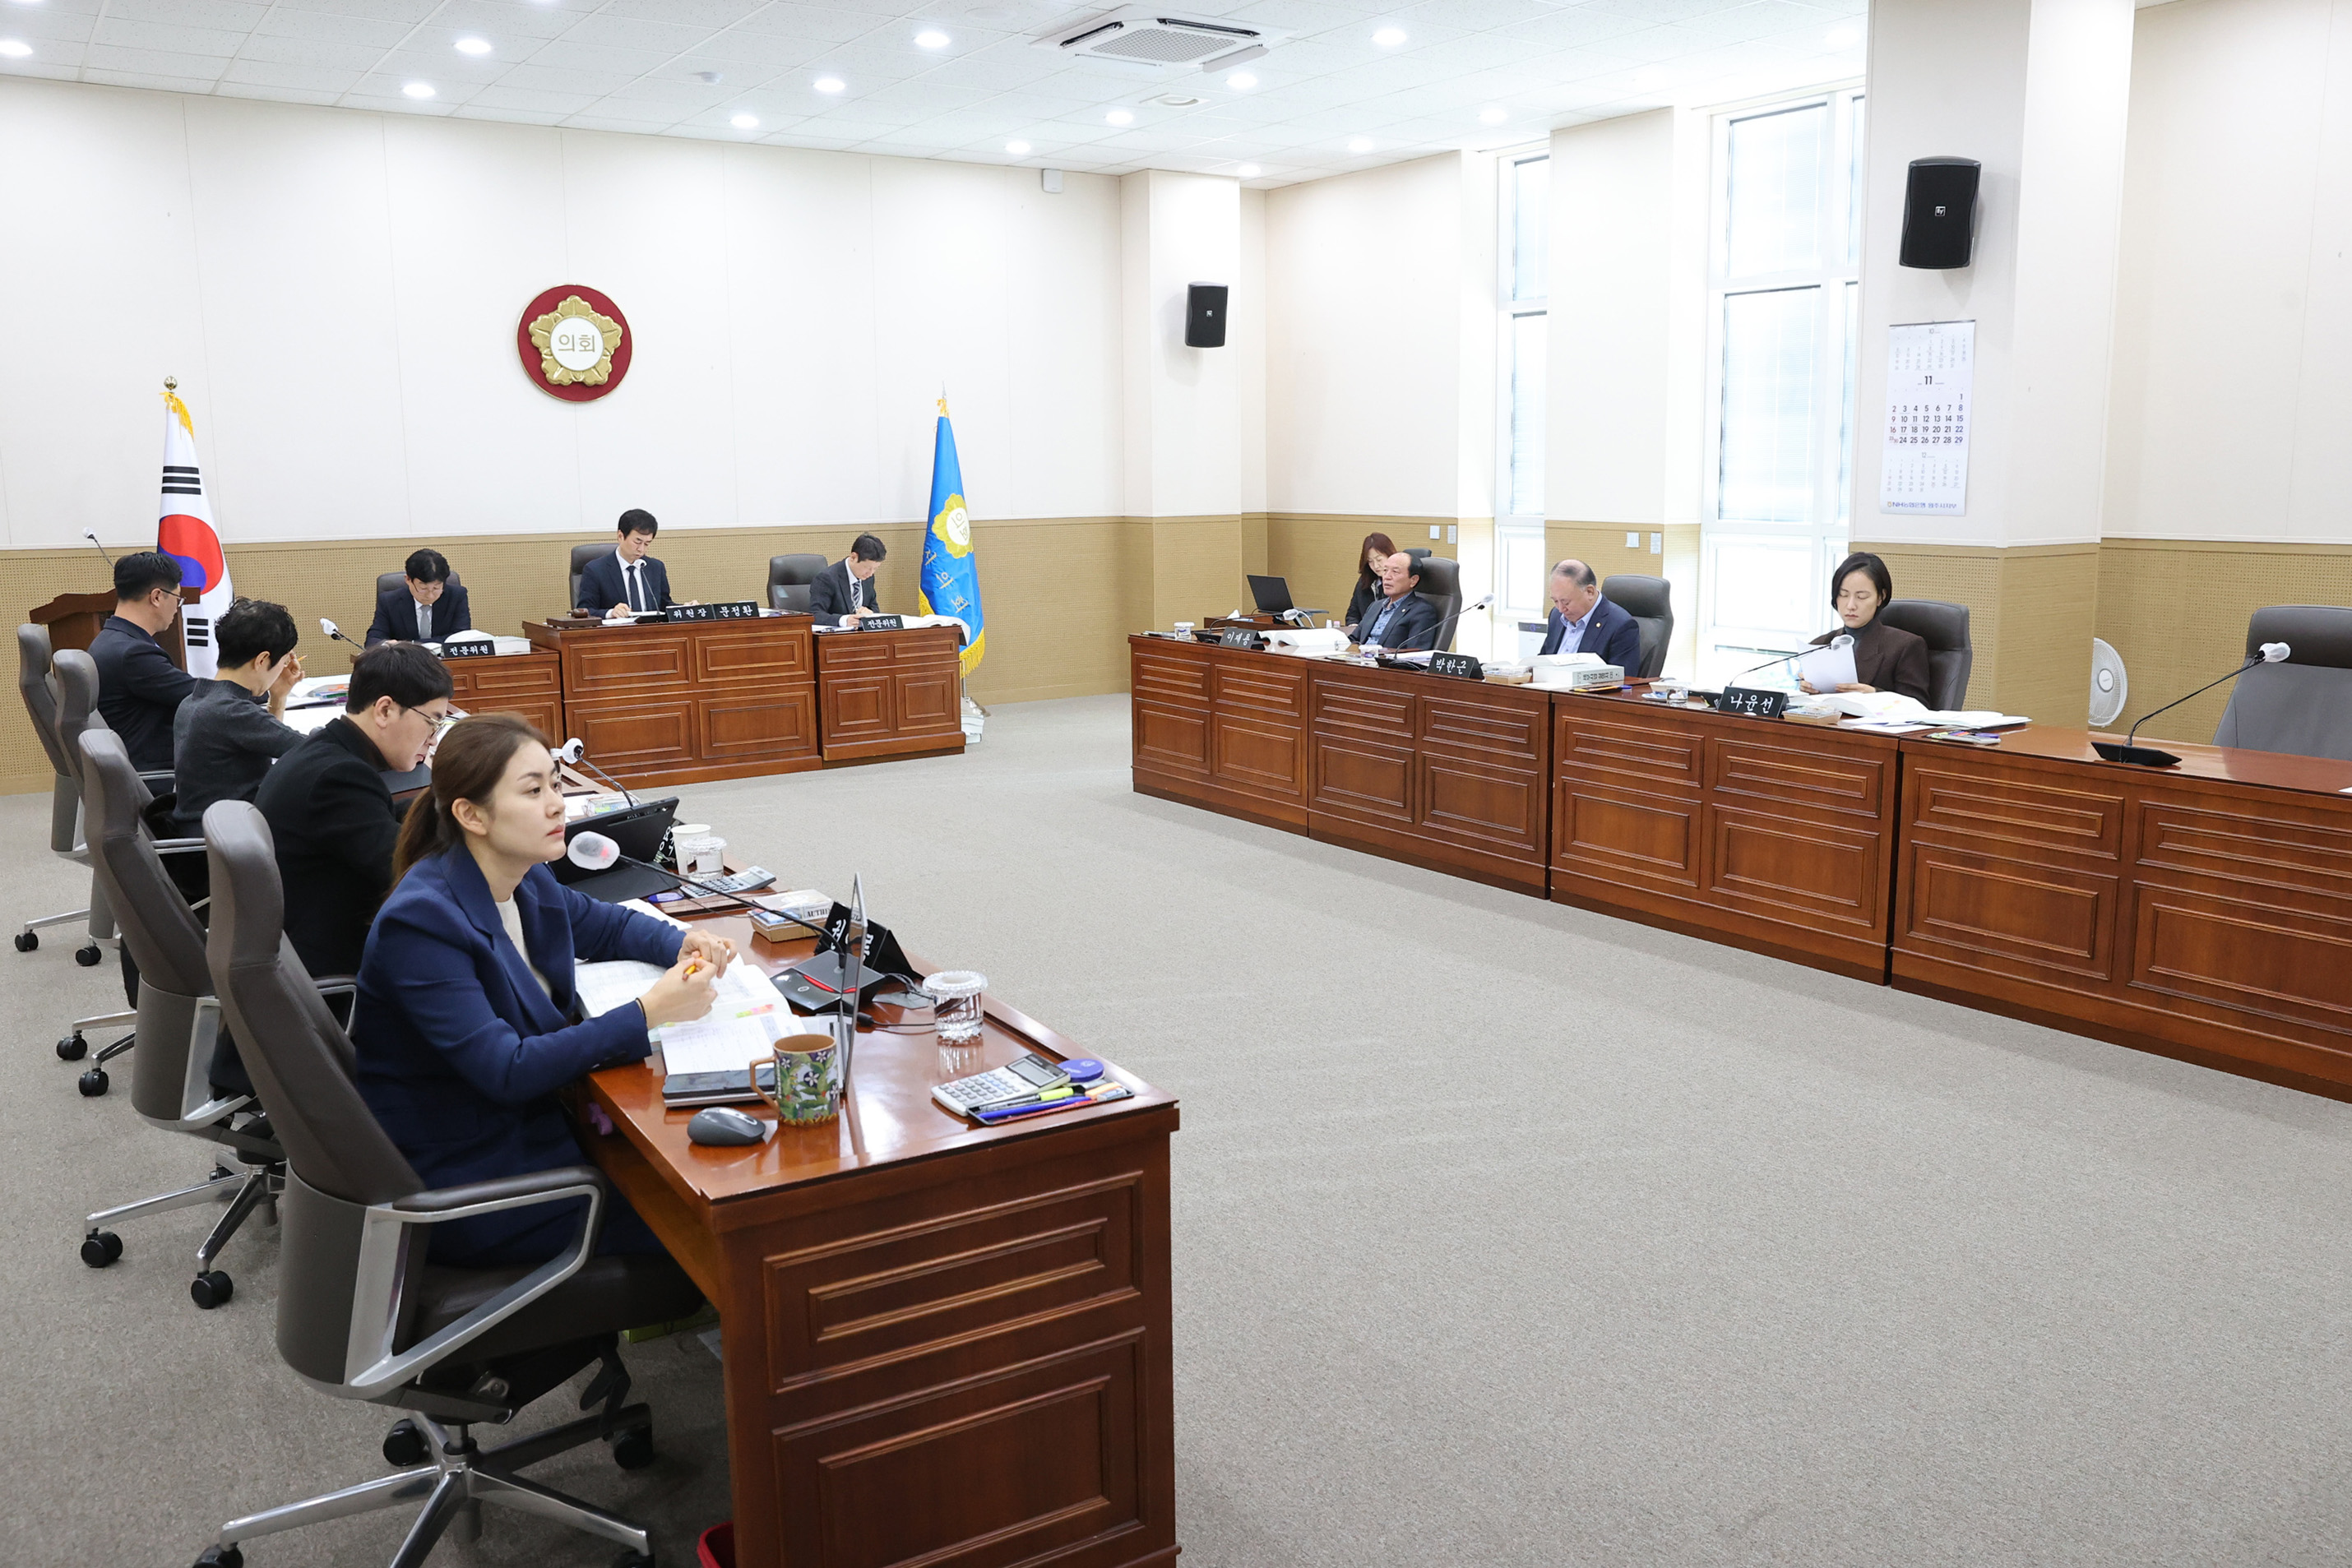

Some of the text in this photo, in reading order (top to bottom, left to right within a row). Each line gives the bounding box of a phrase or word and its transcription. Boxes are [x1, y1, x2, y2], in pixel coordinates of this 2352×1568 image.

[558, 335, 595, 352] 의회
[1924, 376, 1933, 385] 11
[674, 605, 753, 618] 위원장 문정환
[868, 618, 896, 628] 전문위원
[1227, 631, 1251, 646] 이재용
[450, 645, 488, 656] 전문위원
[1436, 658, 1467, 675] 박한근
[1730, 692, 1774, 714] 나윤선
